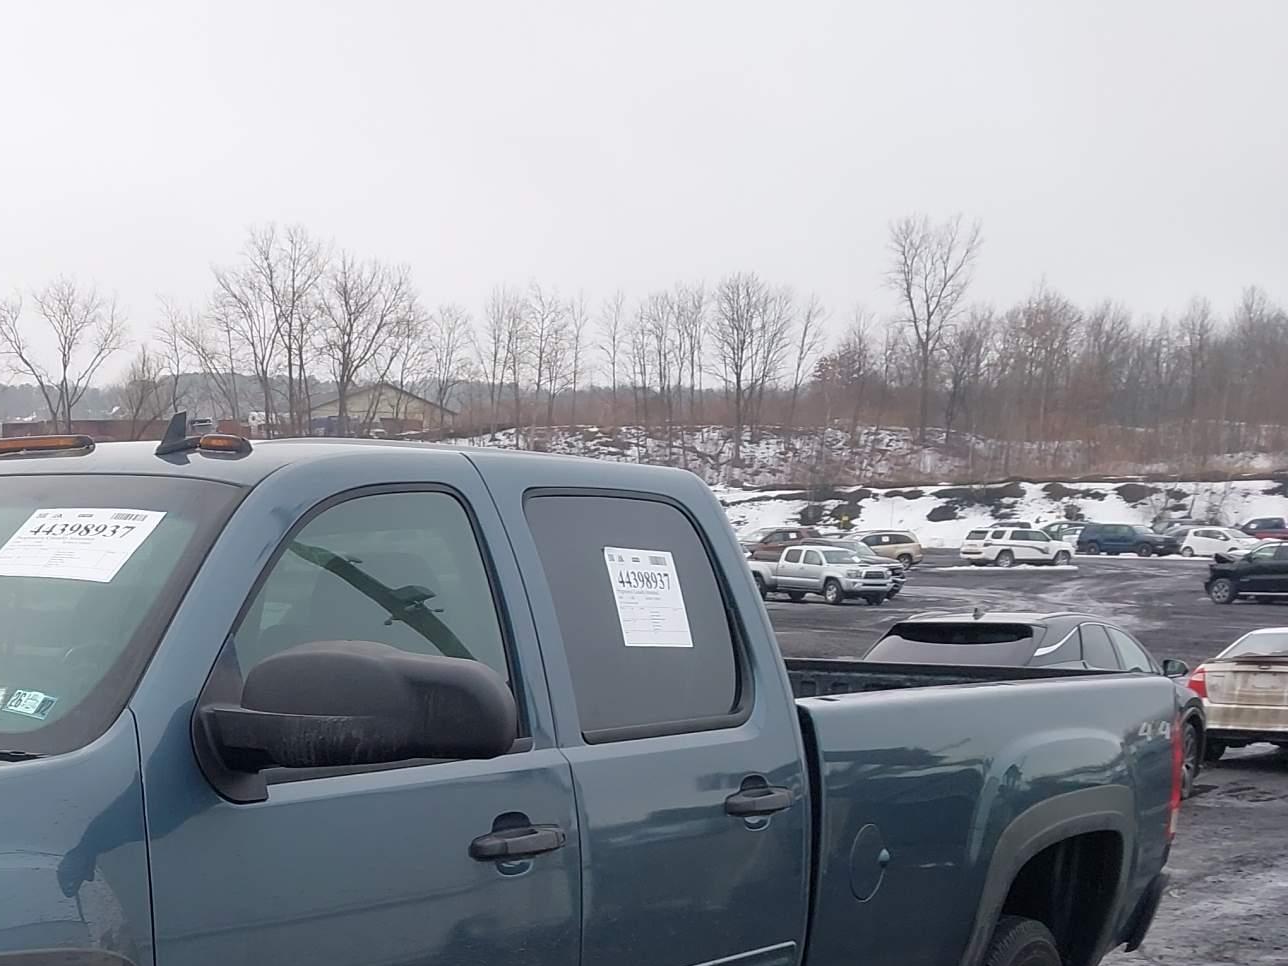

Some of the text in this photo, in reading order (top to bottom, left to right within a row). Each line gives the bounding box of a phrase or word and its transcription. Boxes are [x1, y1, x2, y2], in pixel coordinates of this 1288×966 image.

[29, 523, 136, 540] 44398937
[617, 569, 671, 591] 44398937
[1137, 720, 1171, 742] 44
